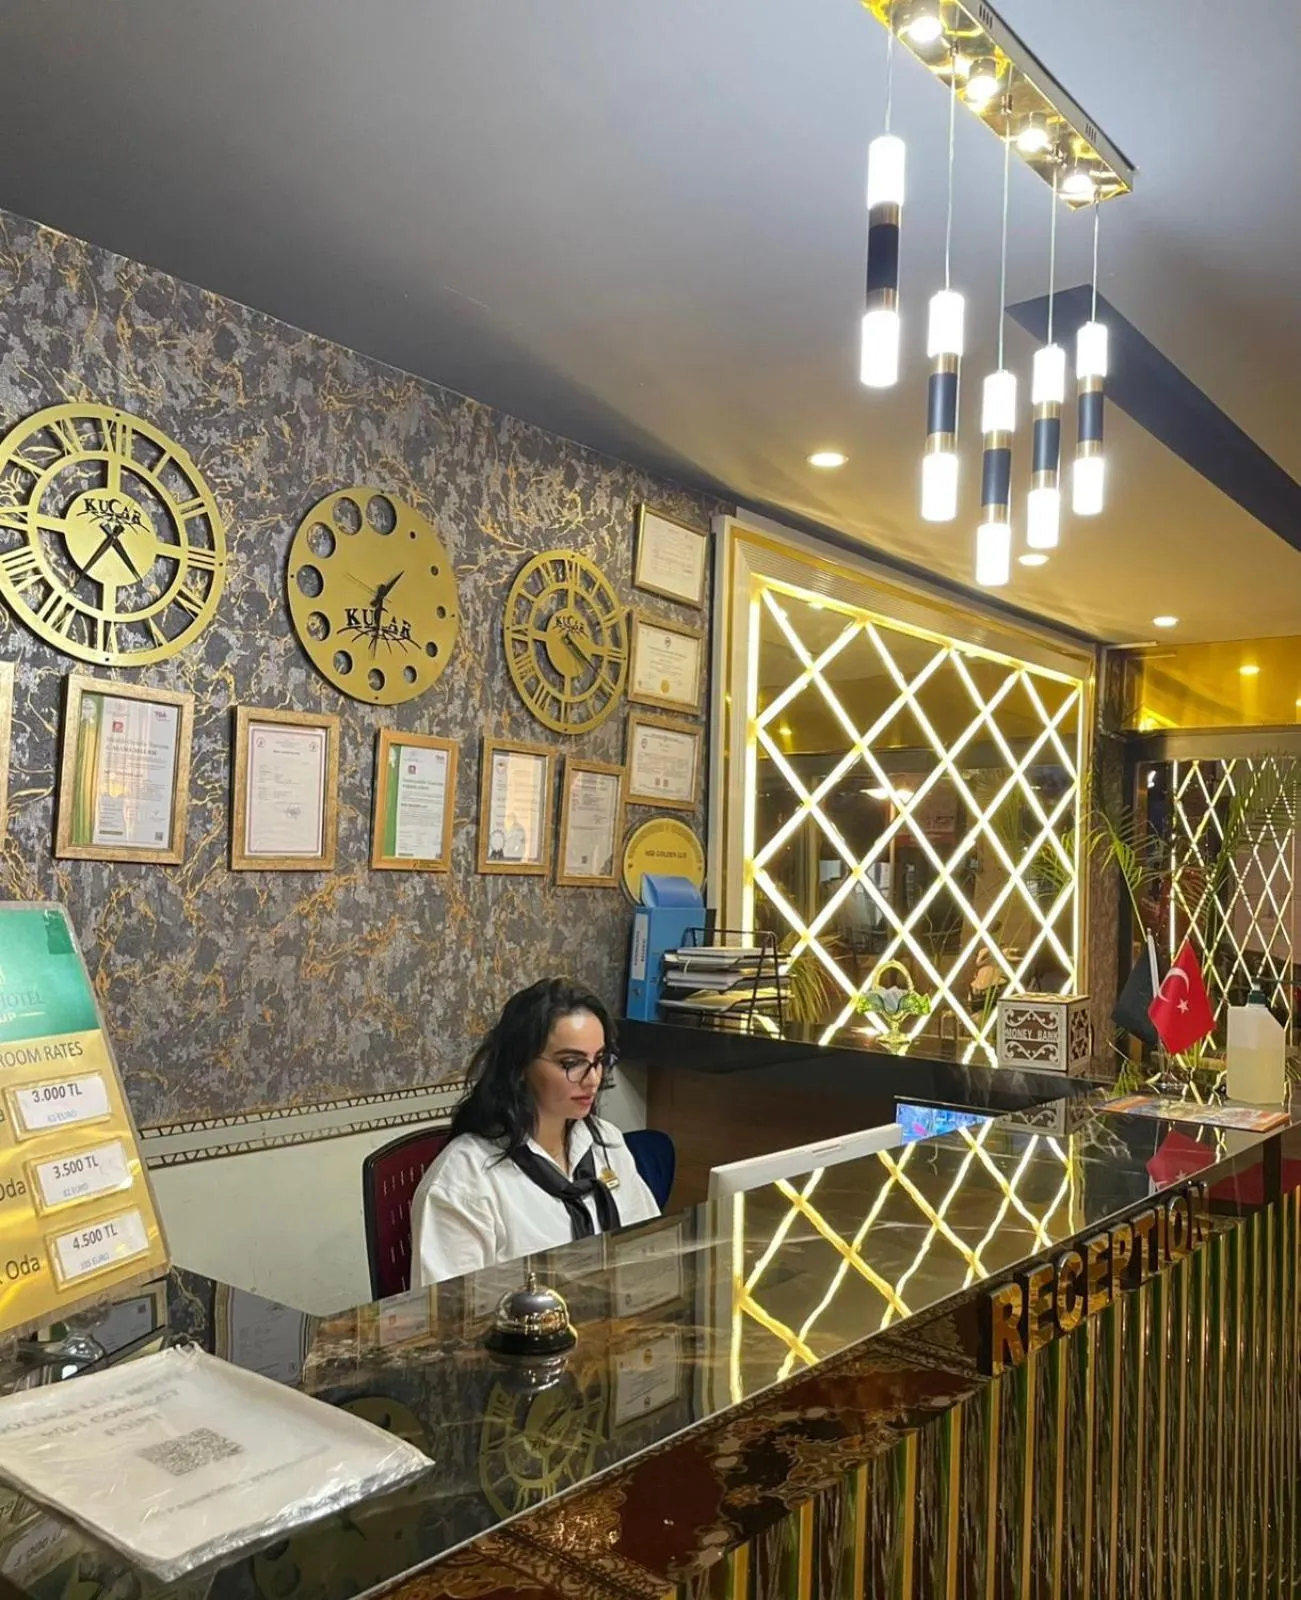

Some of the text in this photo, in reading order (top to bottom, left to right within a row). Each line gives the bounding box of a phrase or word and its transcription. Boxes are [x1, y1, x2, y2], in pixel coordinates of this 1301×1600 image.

[43, 1041, 84, 1061] RATES
[32, 1082, 83, 1103] 3.000 TL
[53, 1154, 100, 1180] 3.500 TL
[72, 1222, 118, 1249] 4.500 TL
[6, 1254, 40, 1280] Oda
[990, 1182, 1210, 1379] RECEPTION
